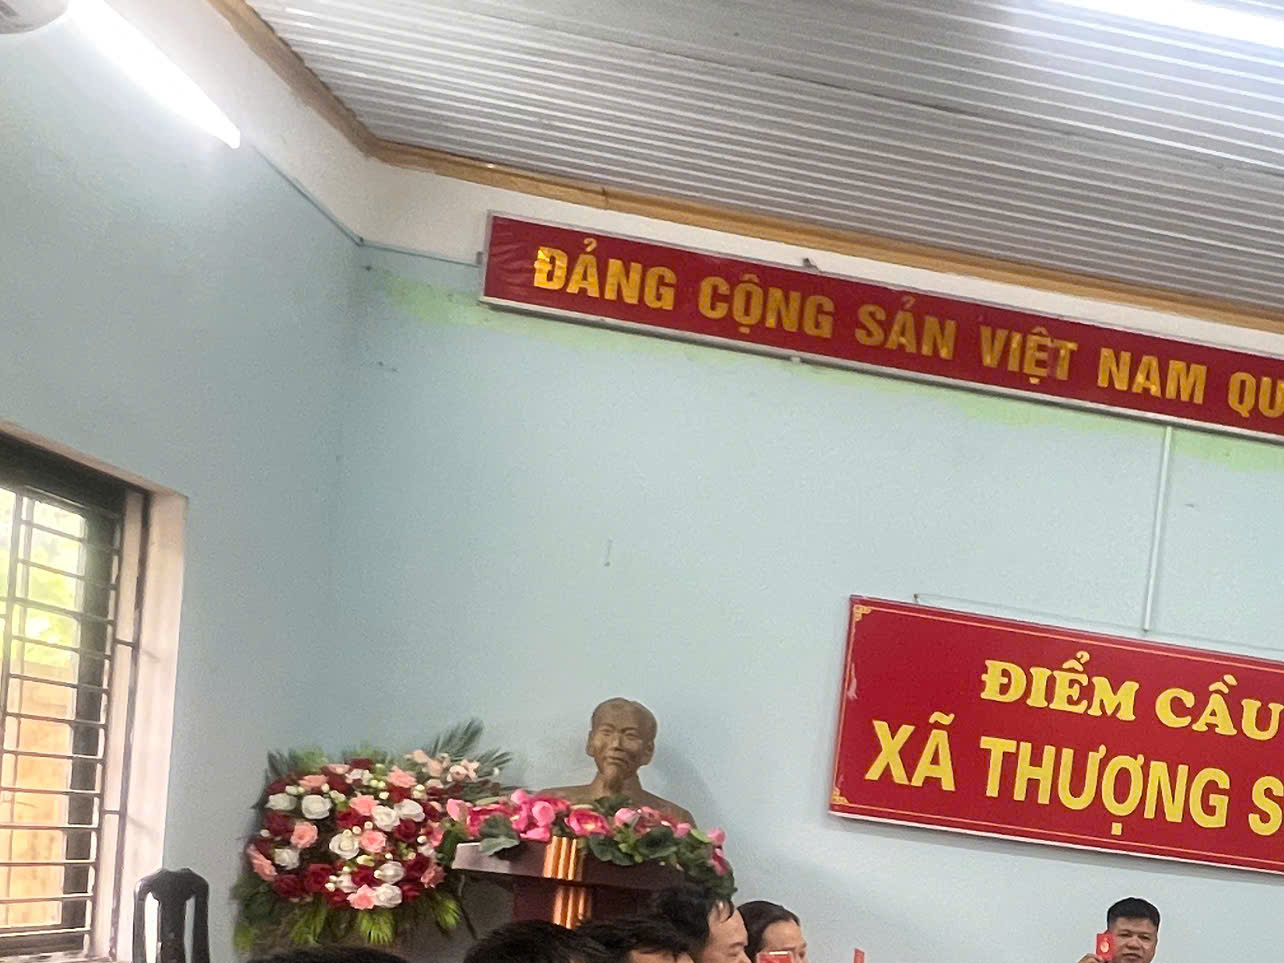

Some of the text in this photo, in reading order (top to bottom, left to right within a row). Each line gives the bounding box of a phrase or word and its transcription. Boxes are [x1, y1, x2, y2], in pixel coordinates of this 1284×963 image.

[533, 238, 676, 311] ĐẢNG
[698, 274, 835, 338] CỘNG
[855, 298, 957, 360] SẢN
[980, 327, 1078, 384] VIỆT
[1097, 347, 1207, 404] NAM
[980, 651, 1284, 740] ĐIỂM CẦU
[865, 712, 956, 791] XÃ
[980, 735, 1231, 836] THƯỢNG
